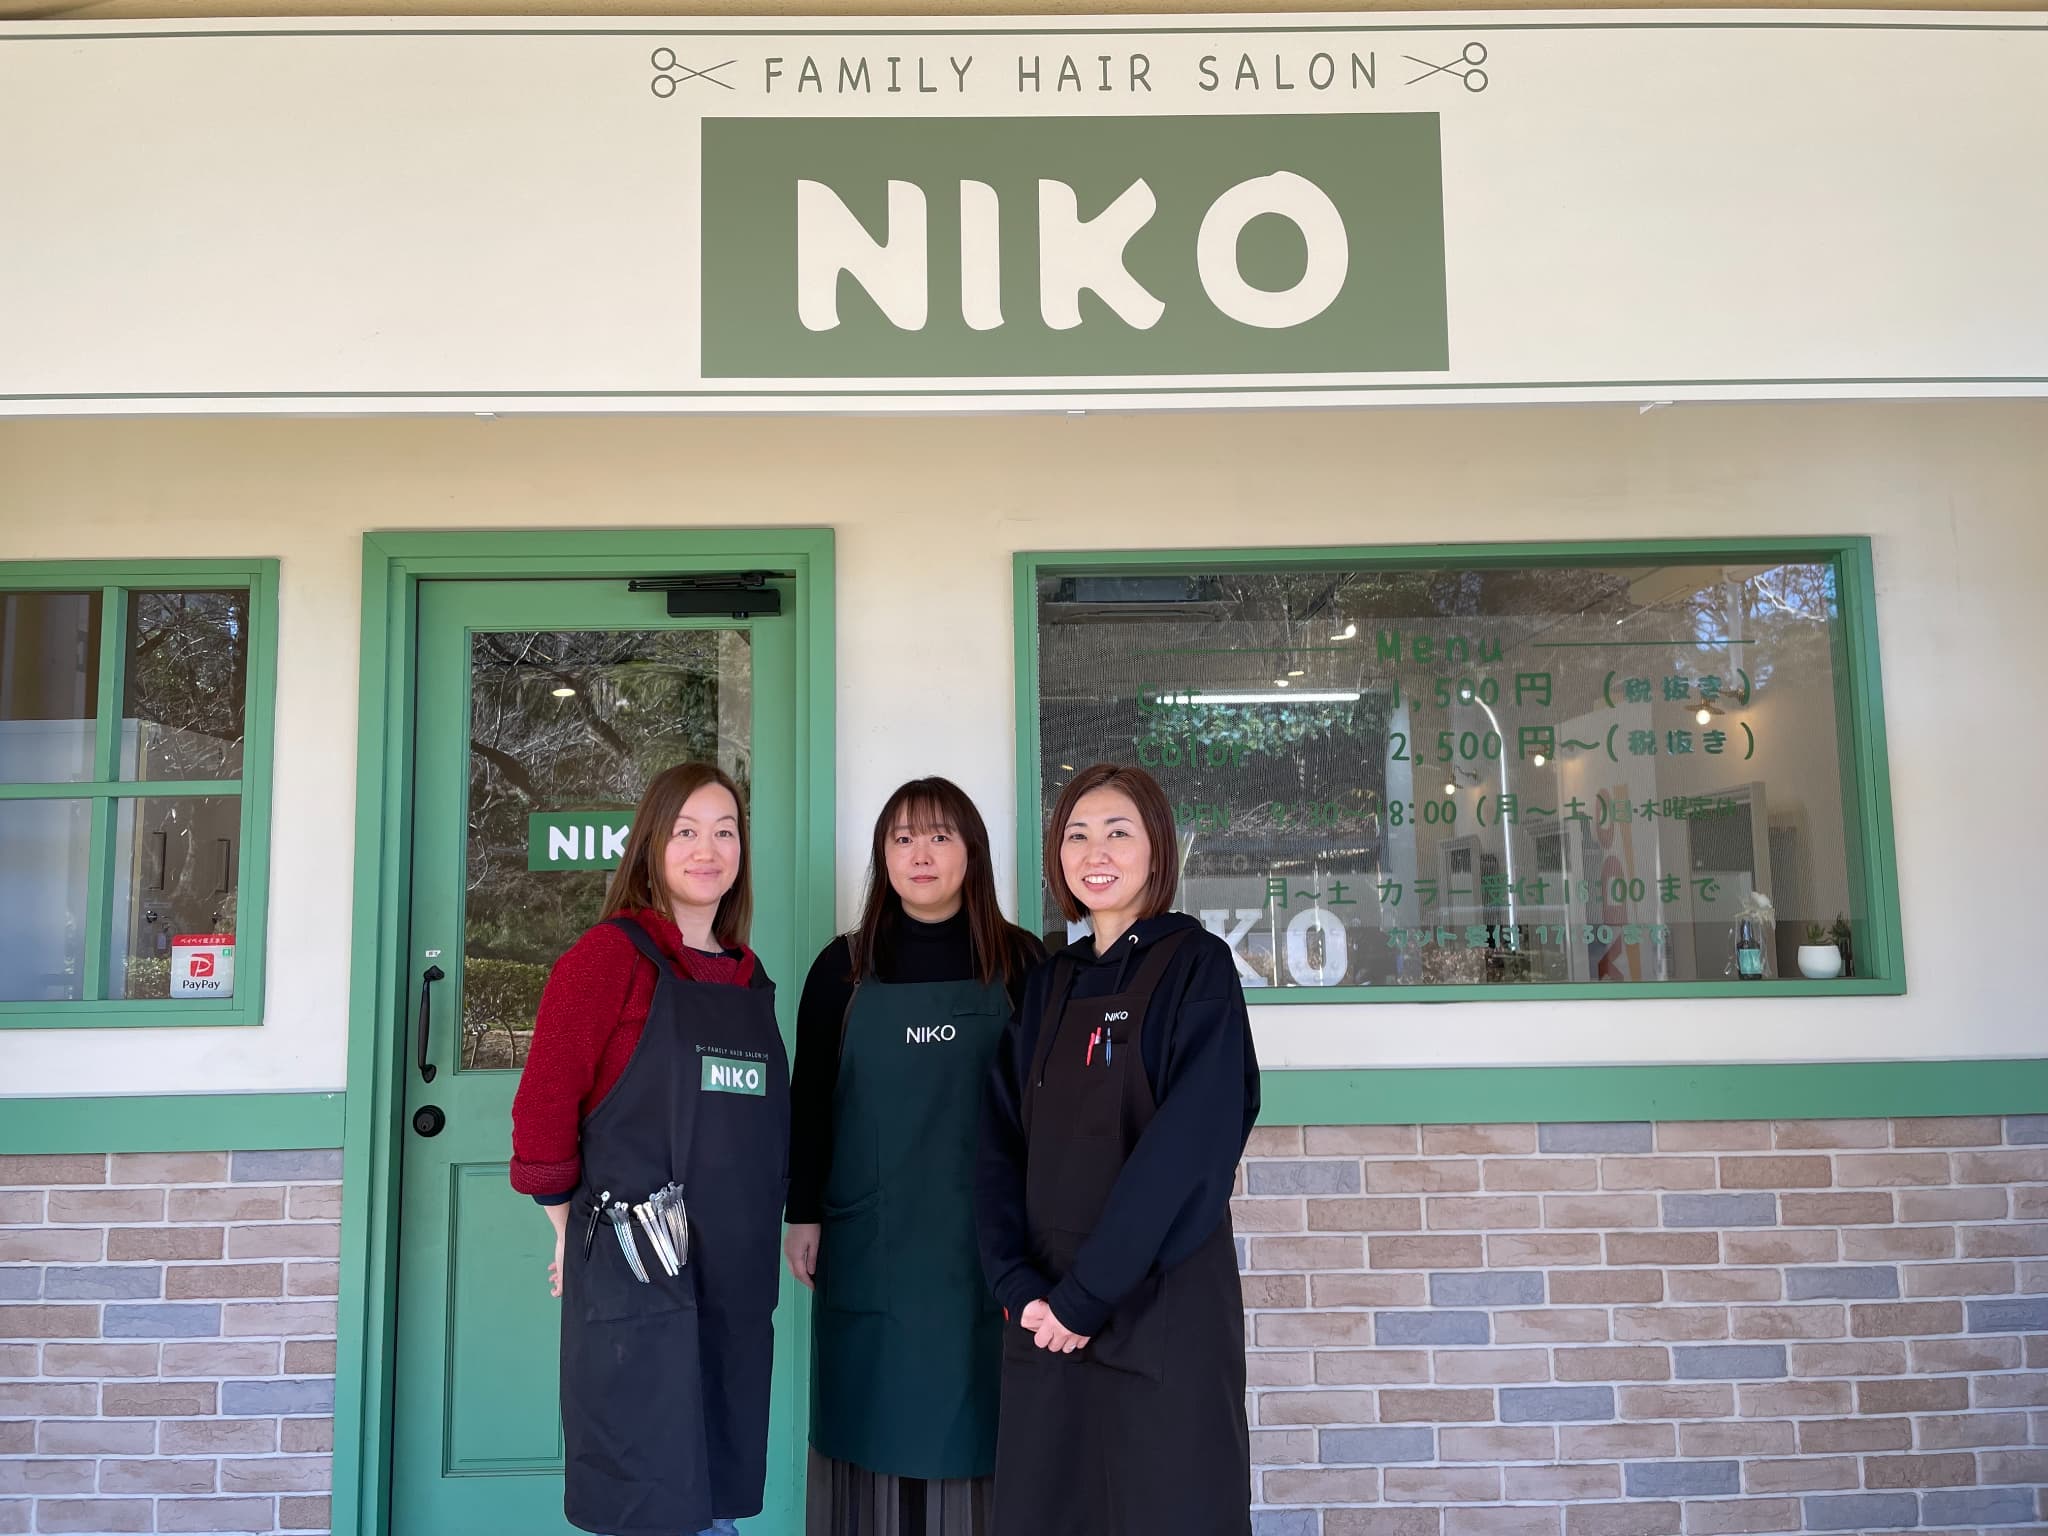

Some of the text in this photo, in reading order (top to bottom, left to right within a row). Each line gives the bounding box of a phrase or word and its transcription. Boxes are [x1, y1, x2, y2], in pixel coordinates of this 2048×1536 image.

[765, 51, 1377, 94] FAMILY HAIR SALON
[797, 170, 1349, 331] NIKO
[1376, 632, 1504, 664] Menu
[1136, 683, 1202, 713] Cut
[1138, 734, 1251, 768] Color
[549, 824, 630, 861] NIK
[182, 979, 221, 990] PayPay
[1104, 1010, 1129, 1022] NIKO
[906, 1024, 957, 1044] NIKO
[711, 1064, 759, 1090] NIKO
